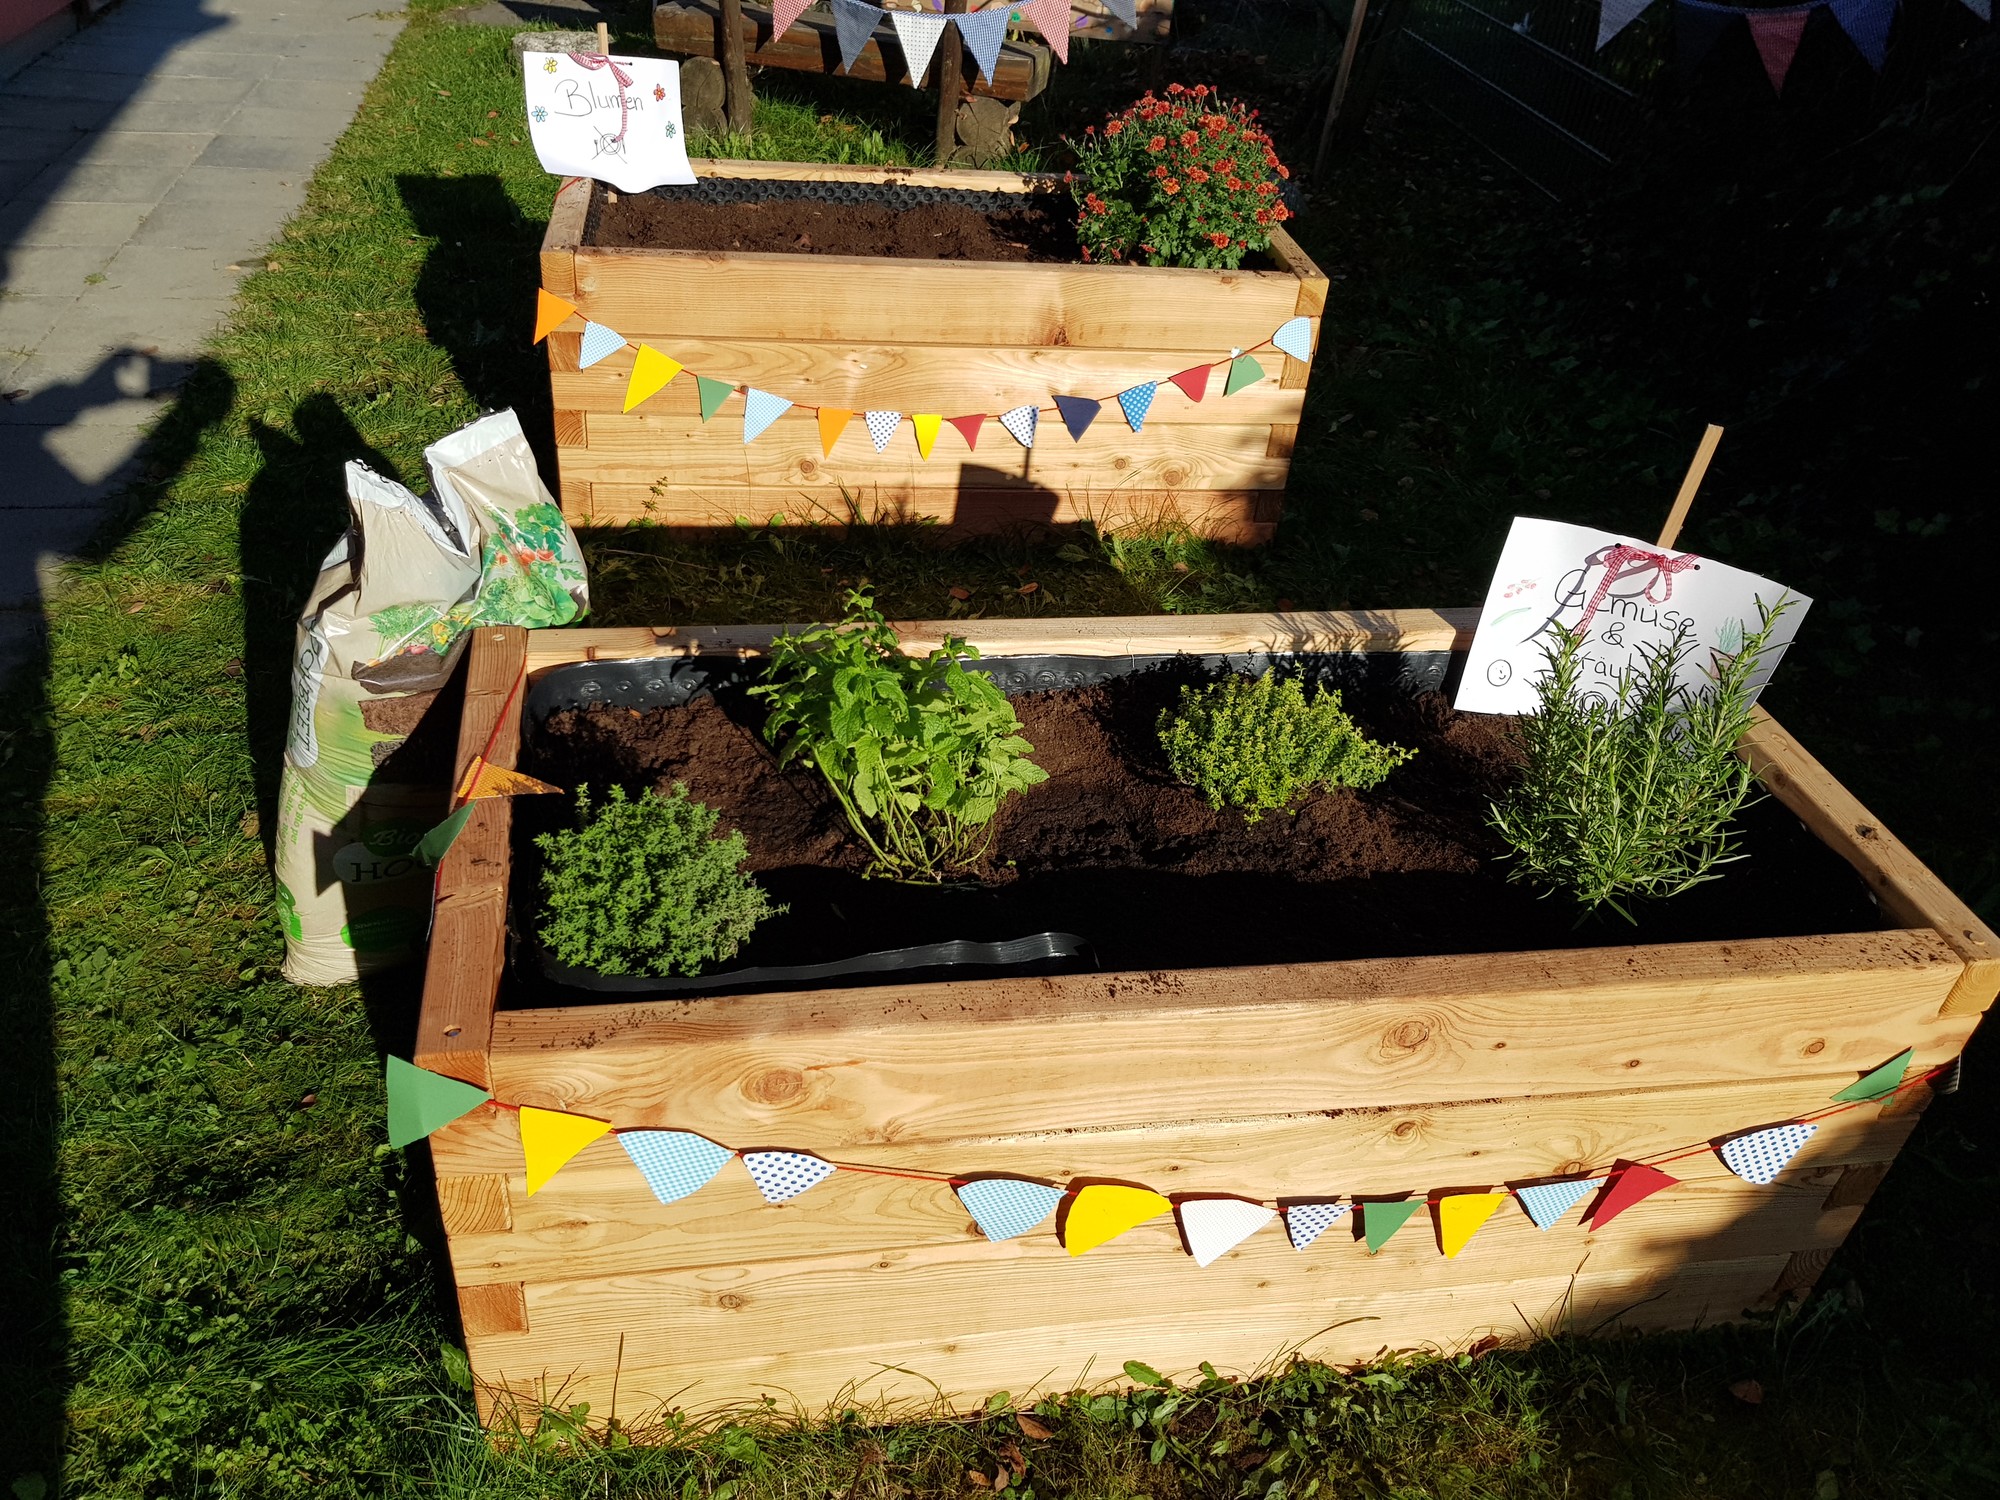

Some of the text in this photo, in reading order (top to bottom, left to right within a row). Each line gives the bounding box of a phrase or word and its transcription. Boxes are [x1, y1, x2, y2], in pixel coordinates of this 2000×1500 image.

[554, 78, 645, 117] Blumen
[1600, 621, 1625, 649] &
[368, 826, 419, 847] Bio
